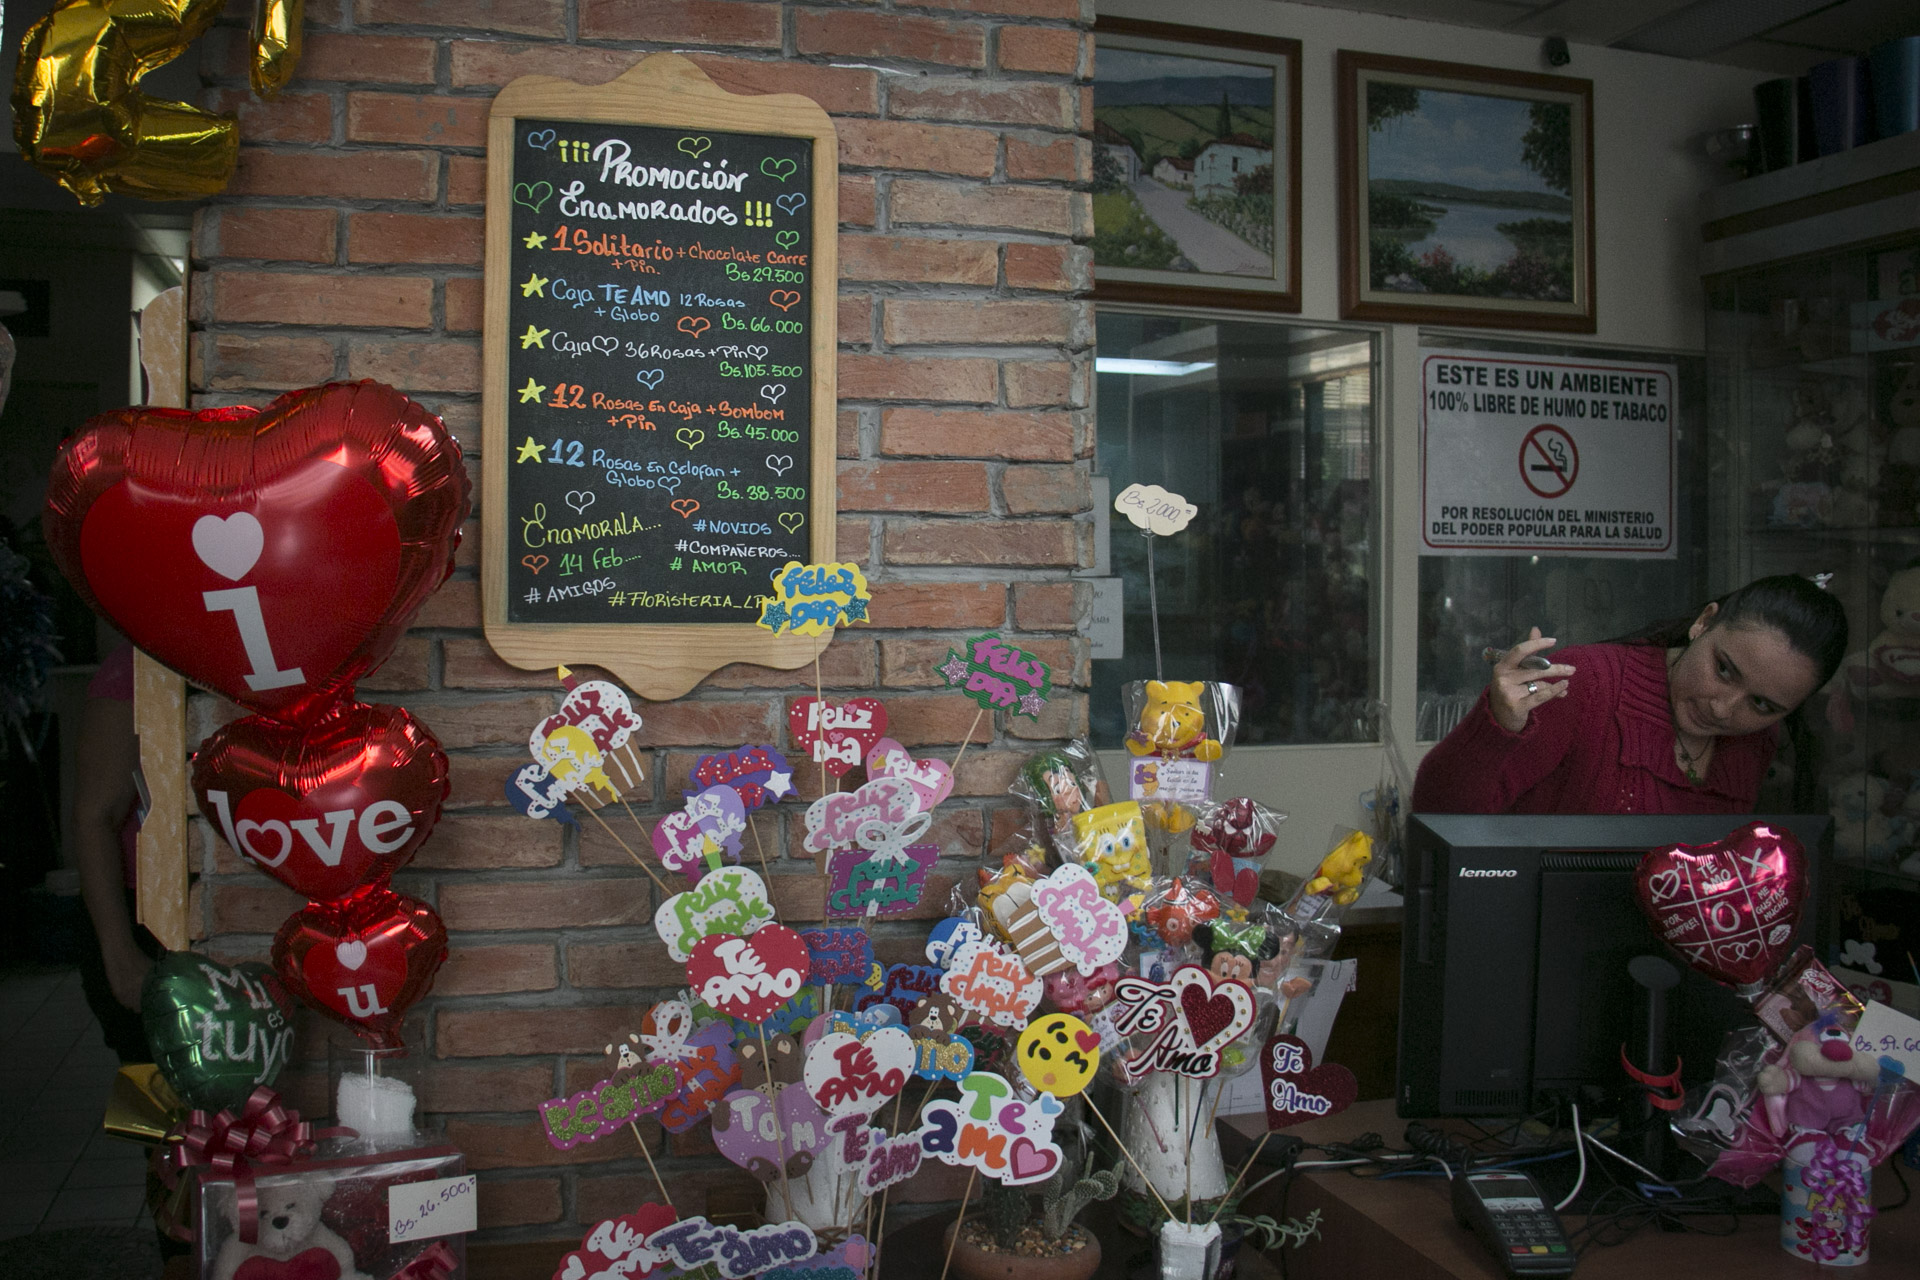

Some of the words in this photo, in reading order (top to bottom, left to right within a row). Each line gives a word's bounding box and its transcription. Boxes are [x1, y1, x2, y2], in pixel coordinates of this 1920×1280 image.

[572, 228, 673, 261] Solitario
[551, 279, 596, 309] Caja
[694, 293, 747, 309] Rosas
[610, 307, 660, 323] Globo
[551, 332, 592, 359] Caja
[650, 341, 707, 361] Rosas
[1437, 364, 1488, 387] ESTE
[1494, 367, 1519, 388] ES
[1526, 370, 1554, 391] UN
[1560, 373, 1658, 398] AMBIENTE
[548, 383, 587, 411] 12
[591, 392, 644, 412] Rosas
[669, 401, 702, 422] Caja
[1429, 390, 1469, 413] 100%
[1473, 393, 1517, 415] LIBRE
[1520, 396, 1540, 417] DE
[1543, 397, 1587, 420] HUMO
[1590, 400, 1609, 421] DE
[1612, 401, 1667, 424] TABACO
[618, 412, 658, 432] Pin
[548, 437, 587, 469] 12
[591, 446, 643, 471] Rosas
[605, 468, 656, 490] Globo
[1441, 505, 1469, 521] POR
[1472, 504, 1555, 523] RESOLUCIÓN
[1559, 508, 1582, 523] DEL
[1585, 509, 1655, 525] MINISTERIO
[1432, 520, 1458, 537] DEL
[1460, 522, 1505, 538] PODER
[1508, 522, 1567, 540] POPULAR
[1569, 524, 1602, 541] PARA
[1605, 525, 1621, 541] LA
[1623, 525, 1663, 543] SALUD
[559, 552, 583, 577] 14
[1459, 867, 1518, 879] lenovo
